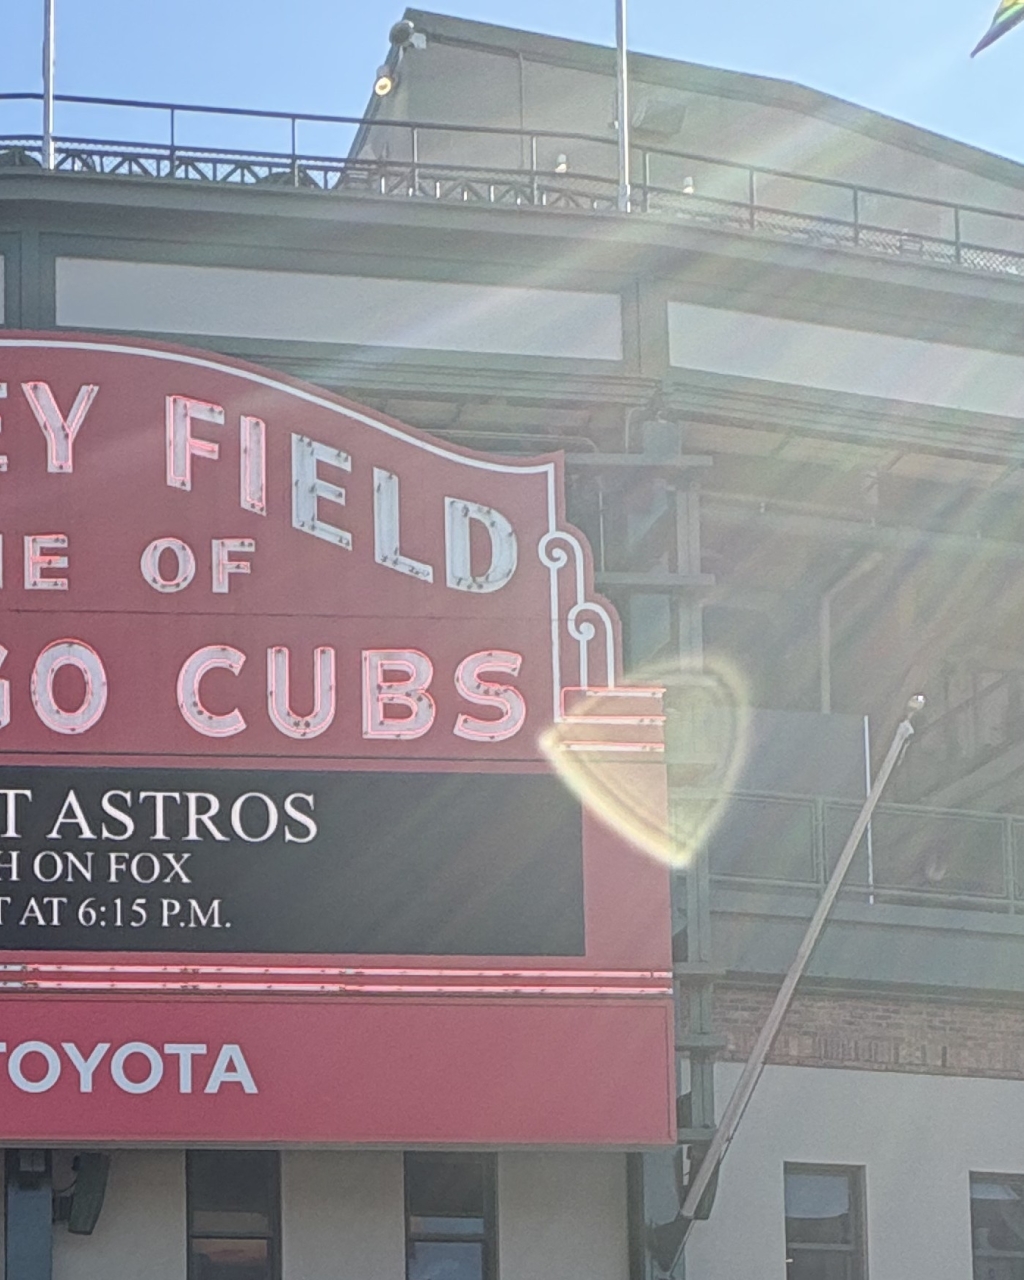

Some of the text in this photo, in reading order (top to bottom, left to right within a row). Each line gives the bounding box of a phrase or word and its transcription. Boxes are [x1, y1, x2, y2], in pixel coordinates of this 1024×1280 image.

[165, 395, 518, 593] FIELD
[140, 537, 256, 593] OF
[176, 645, 527, 742] CUBS
[46, 790, 318, 844] ASTROS
[33, 851, 94, 884] ON
[107, 852, 192, 884] FOX
[19, 897, 68, 927] AT
[77, 898, 148, 928] 6:15
[160, 899, 232, 929] P.M.
